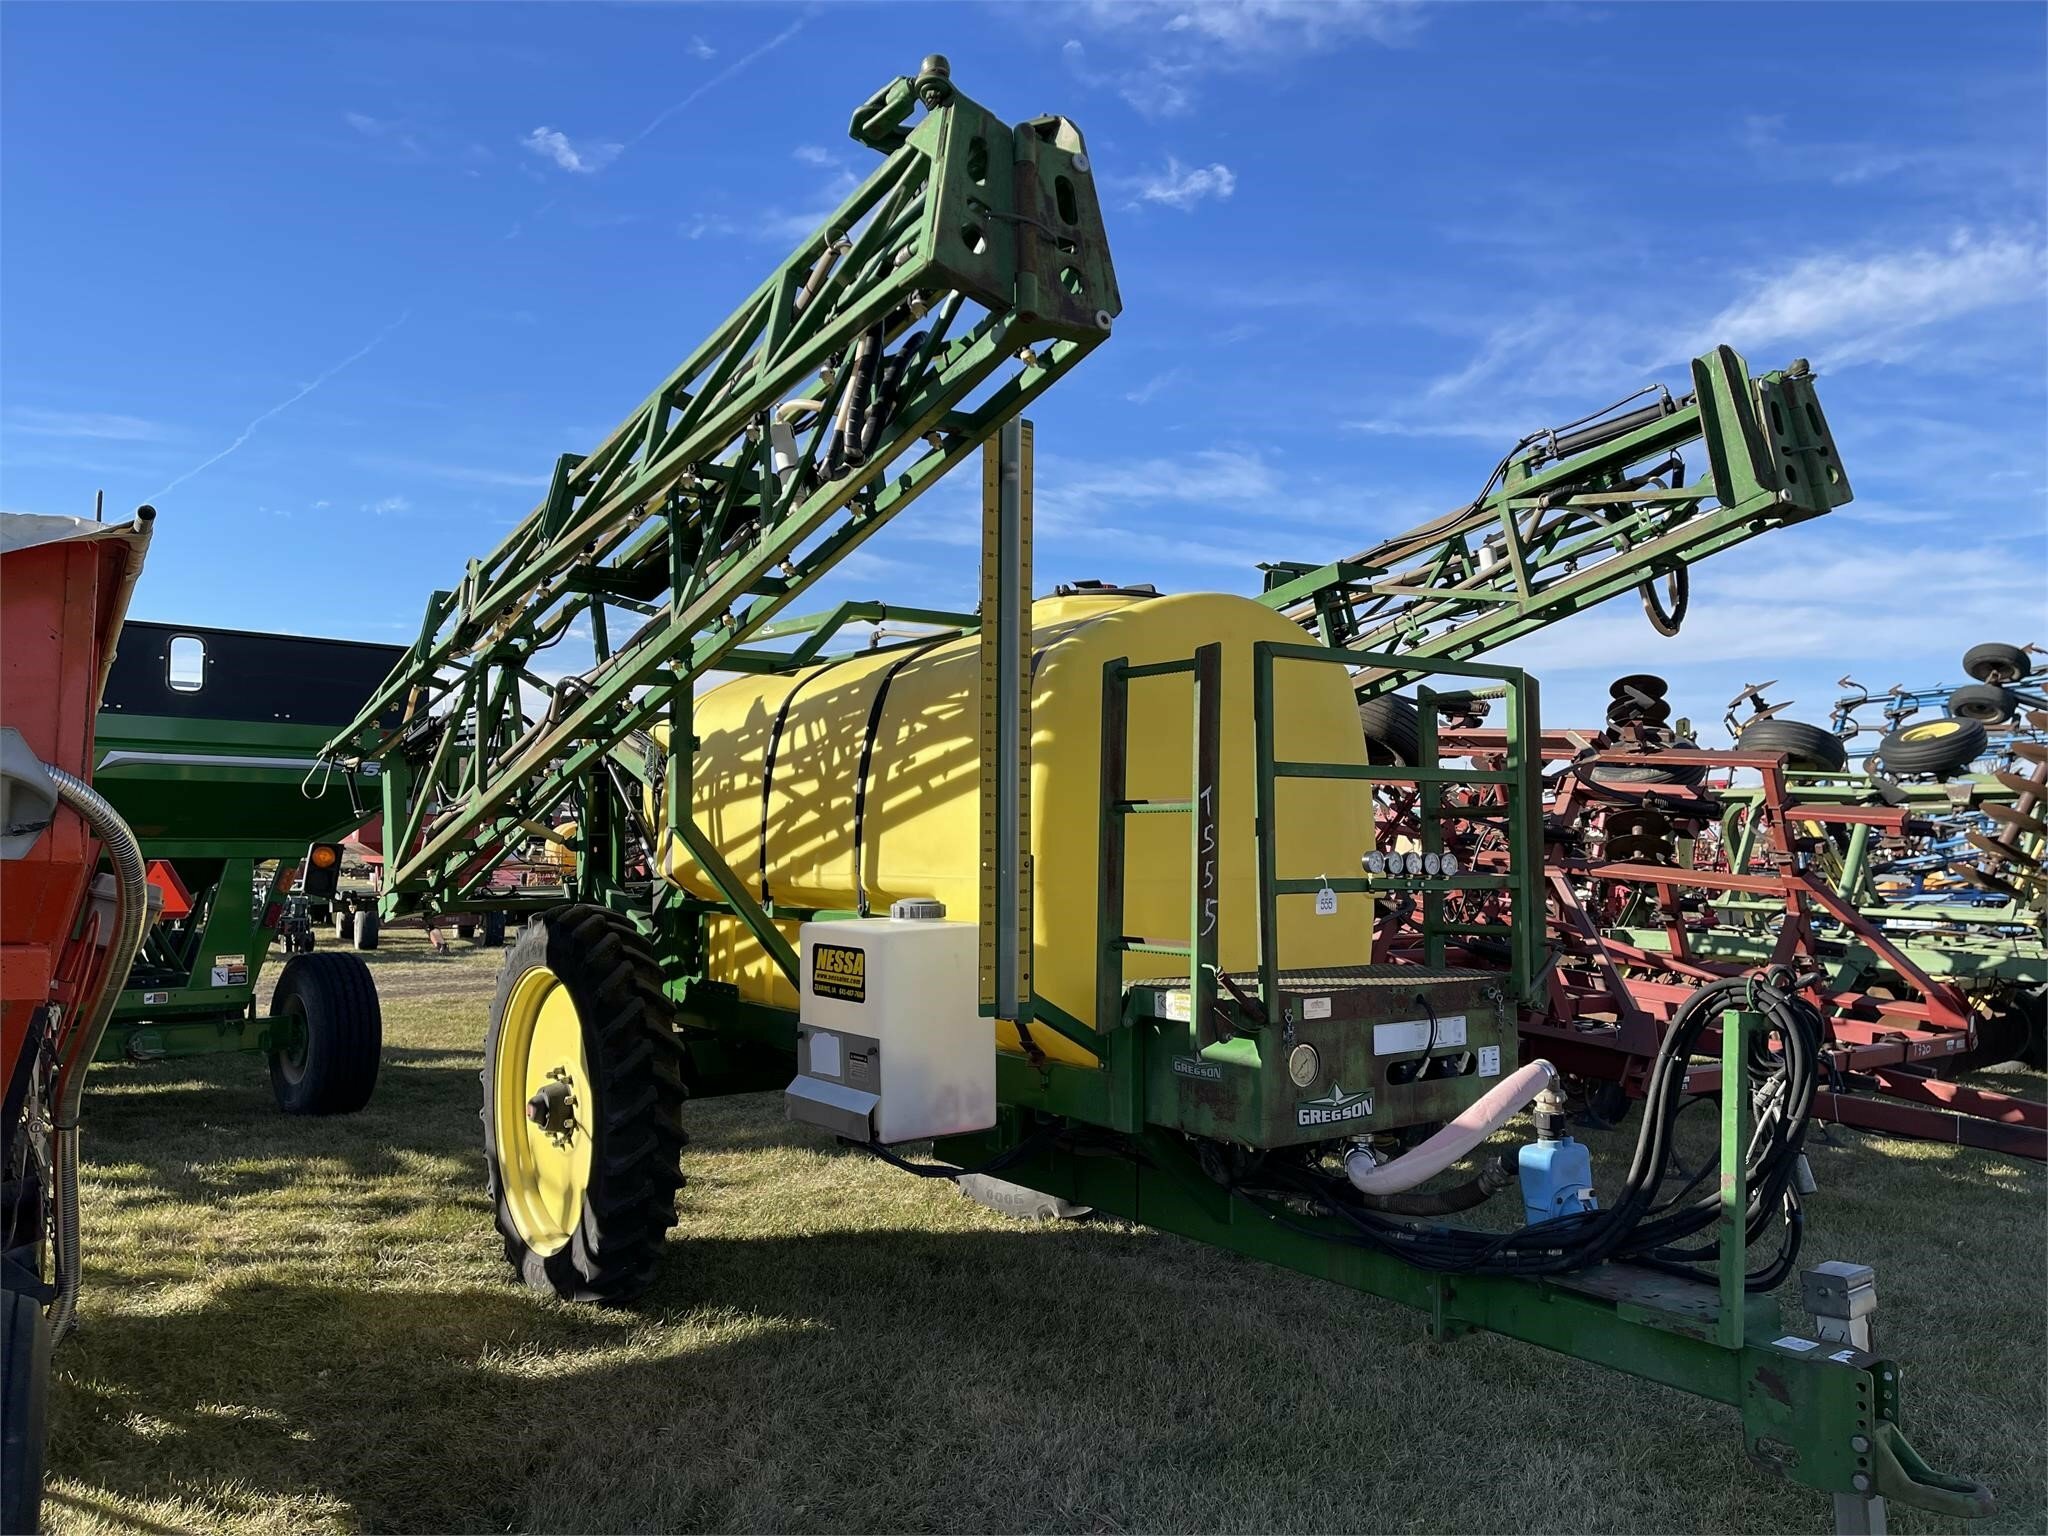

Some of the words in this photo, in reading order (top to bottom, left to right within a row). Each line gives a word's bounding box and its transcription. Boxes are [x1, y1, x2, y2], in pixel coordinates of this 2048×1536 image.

[1320, 897, 1333, 911] 555
[816, 947, 864, 976] NESSA
[1174, 1060, 1221, 1079] GREGSON
[1298, 1097, 1373, 1125] GREGSON
